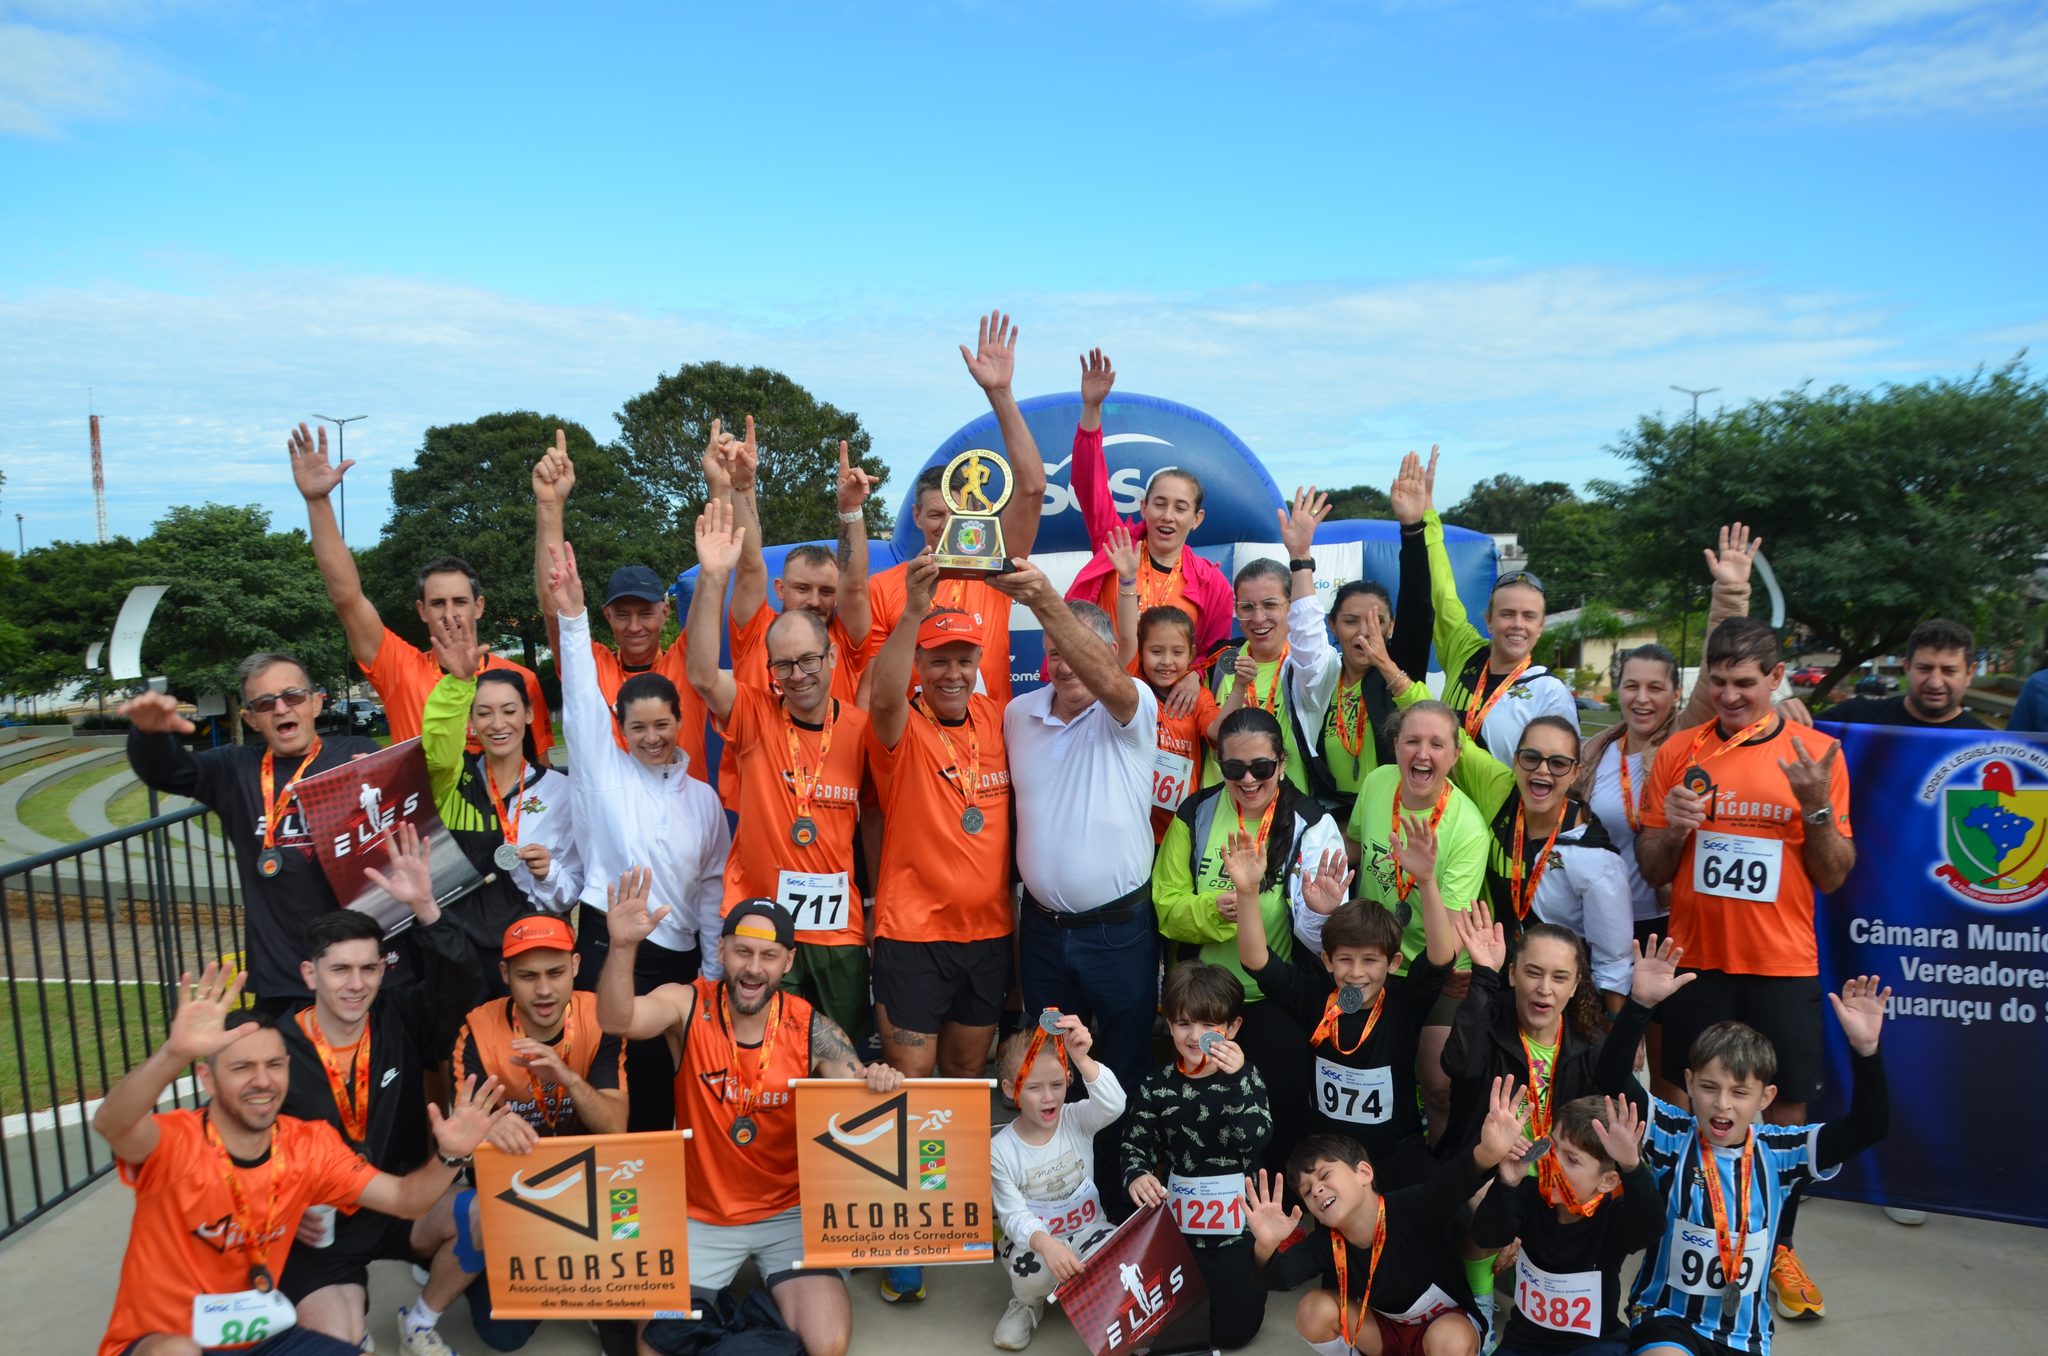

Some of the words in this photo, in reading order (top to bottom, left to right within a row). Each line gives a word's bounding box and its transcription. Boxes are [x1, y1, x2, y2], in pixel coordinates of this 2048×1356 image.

[1923, 766, 1951, 800] PODER
[1950, 745, 2026, 768] LEGISLATIVO
[1703, 855, 1767, 895] 649
[788, 893, 843, 925] 717
[1849, 917, 1959, 949] Câmara
[1899, 956, 2048, 989] Vereadore
[2000, 997, 2037, 1024] do
[1323, 1081, 1383, 1119] 974
[1033, 1160, 1066, 1179] merci
[822, 1201, 979, 1230] ACORSEB
[1171, 1197, 1241, 1230] 1221
[821, 1231, 886, 1244] Associação
[888, 1230, 910, 1241] dos
[913, 1229, 979, 1240] Corredores
[851, 1247, 866, 1259] de
[870, 1247, 892, 1258] Rua
[895, 1245, 910, 1257] de
[913, 1244, 951, 1256] Seberi
[509, 1248, 675, 1282] ACORSEB
[1681, 1249, 1754, 1291] 969
[508, 1283, 577, 1296] Associação
[579, 1281, 602, 1294] dos
[605, 1280, 676, 1294] Corredores
[560, 1298, 584, 1308] Rua
[606, 1298, 646, 1308] Seberi
[1520, 1280, 1591, 1330] 1382
